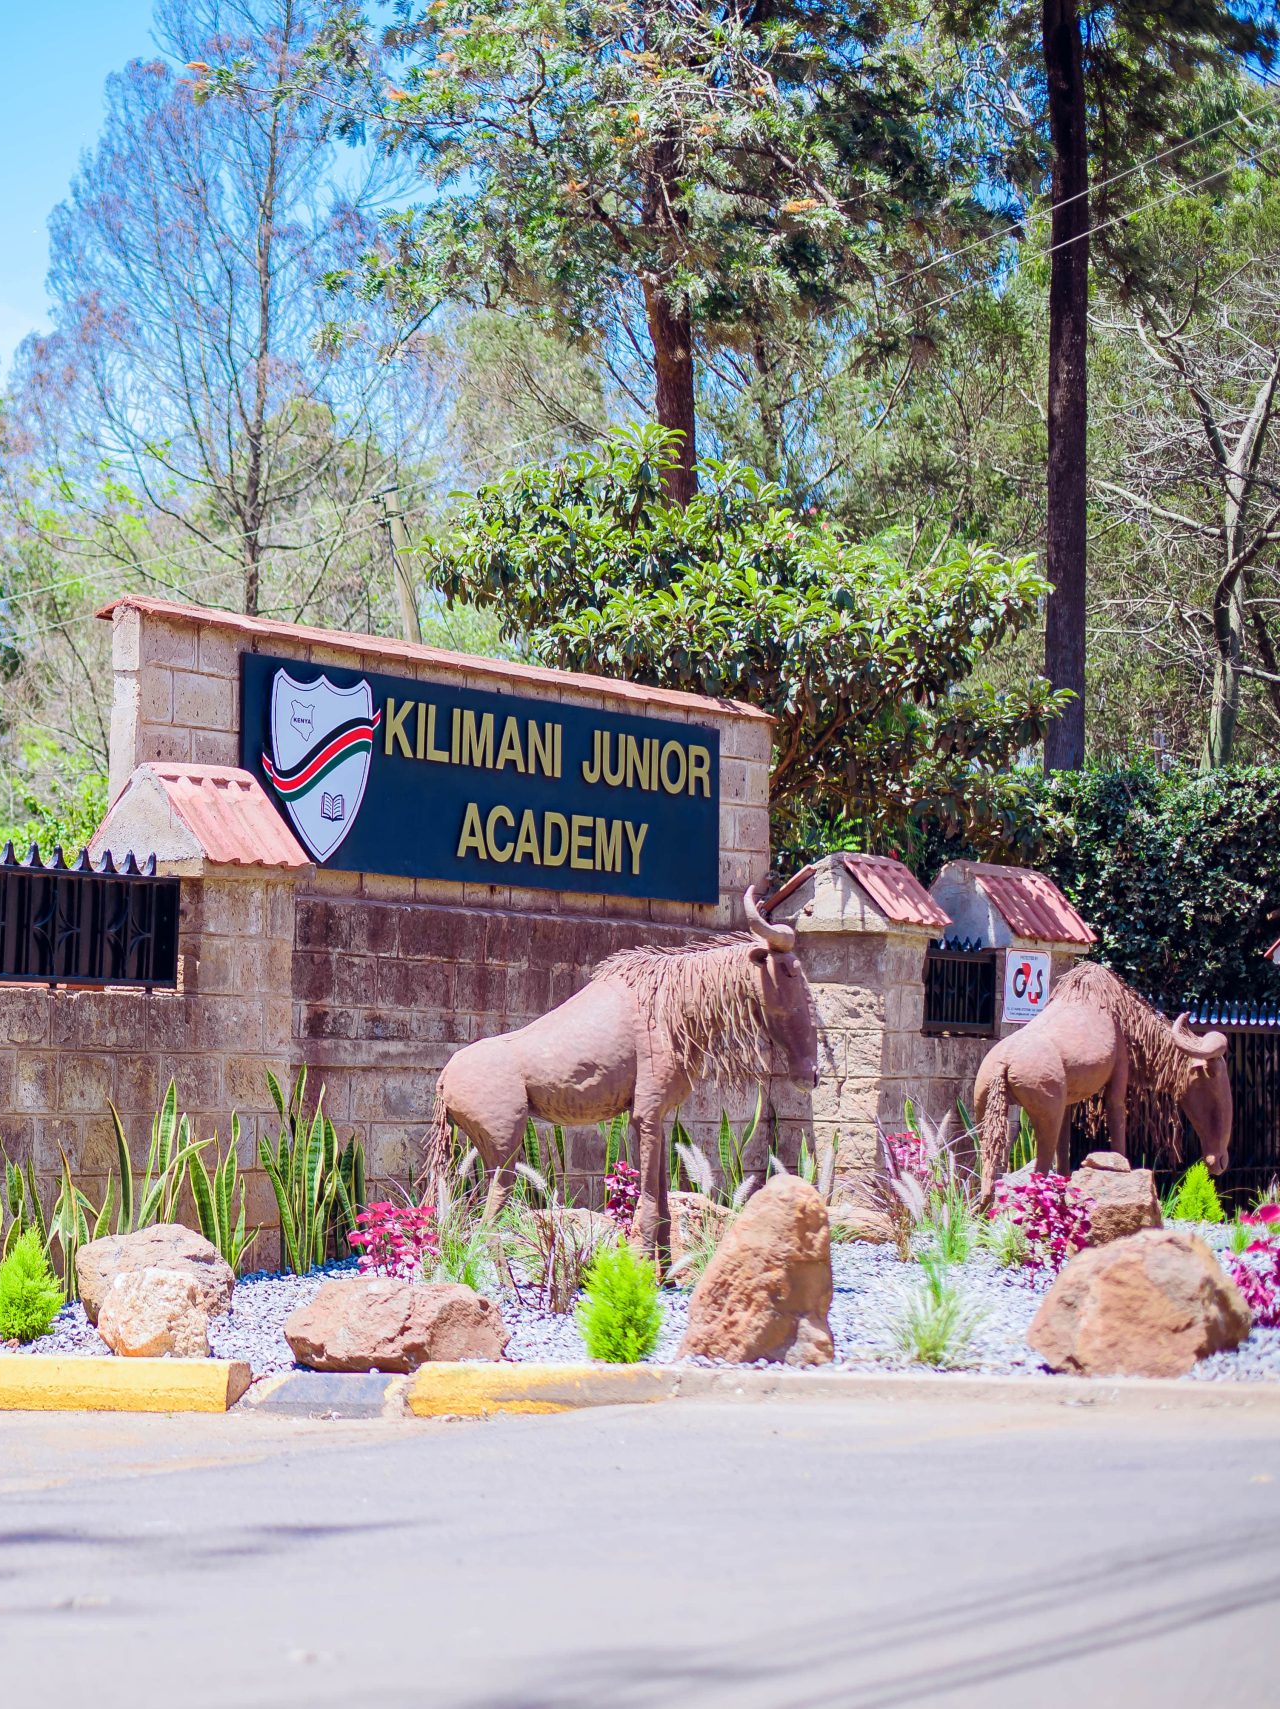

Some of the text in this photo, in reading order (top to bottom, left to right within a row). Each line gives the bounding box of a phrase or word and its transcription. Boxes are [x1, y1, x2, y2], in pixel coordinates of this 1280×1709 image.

[293, 716, 312, 725] KENYA
[384, 697, 712, 798] KILIMANI JUNIOR
[456, 802, 649, 877] ACADEMY
[1012, 962, 1044, 1005] G4S
